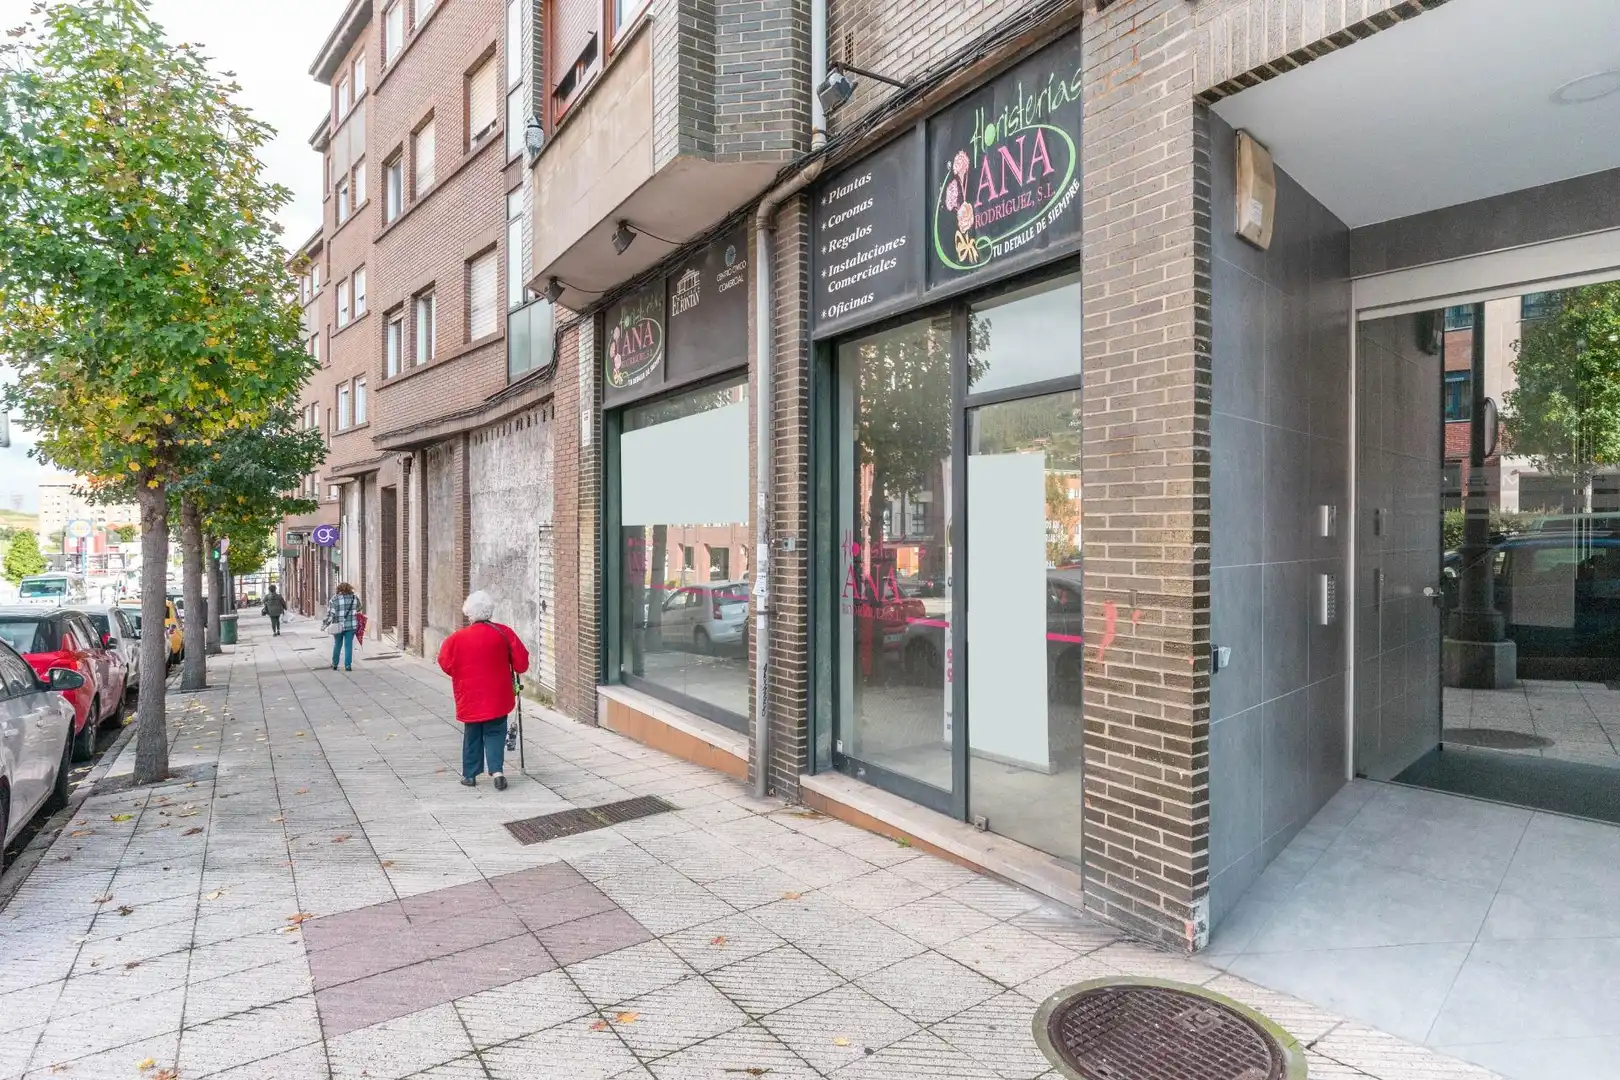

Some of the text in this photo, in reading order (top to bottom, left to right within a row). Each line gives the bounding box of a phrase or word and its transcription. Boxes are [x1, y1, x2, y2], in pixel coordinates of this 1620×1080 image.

[974, 127, 1055, 208] ANA
[828, 172, 872, 204] Plantas
[828, 198, 874, 228] Coronas
[992, 178, 1080, 258] TU DETALLE DE SIEMPRE
[828, 224, 873, 252] Regalos
[828, 235, 906, 278] Instalaciones
[827, 257, 897, 293] Comerciales
[827, 292, 875, 319] Oficinas
[622, 320, 654, 357] ANA
[841, 563, 903, 605] ANA
